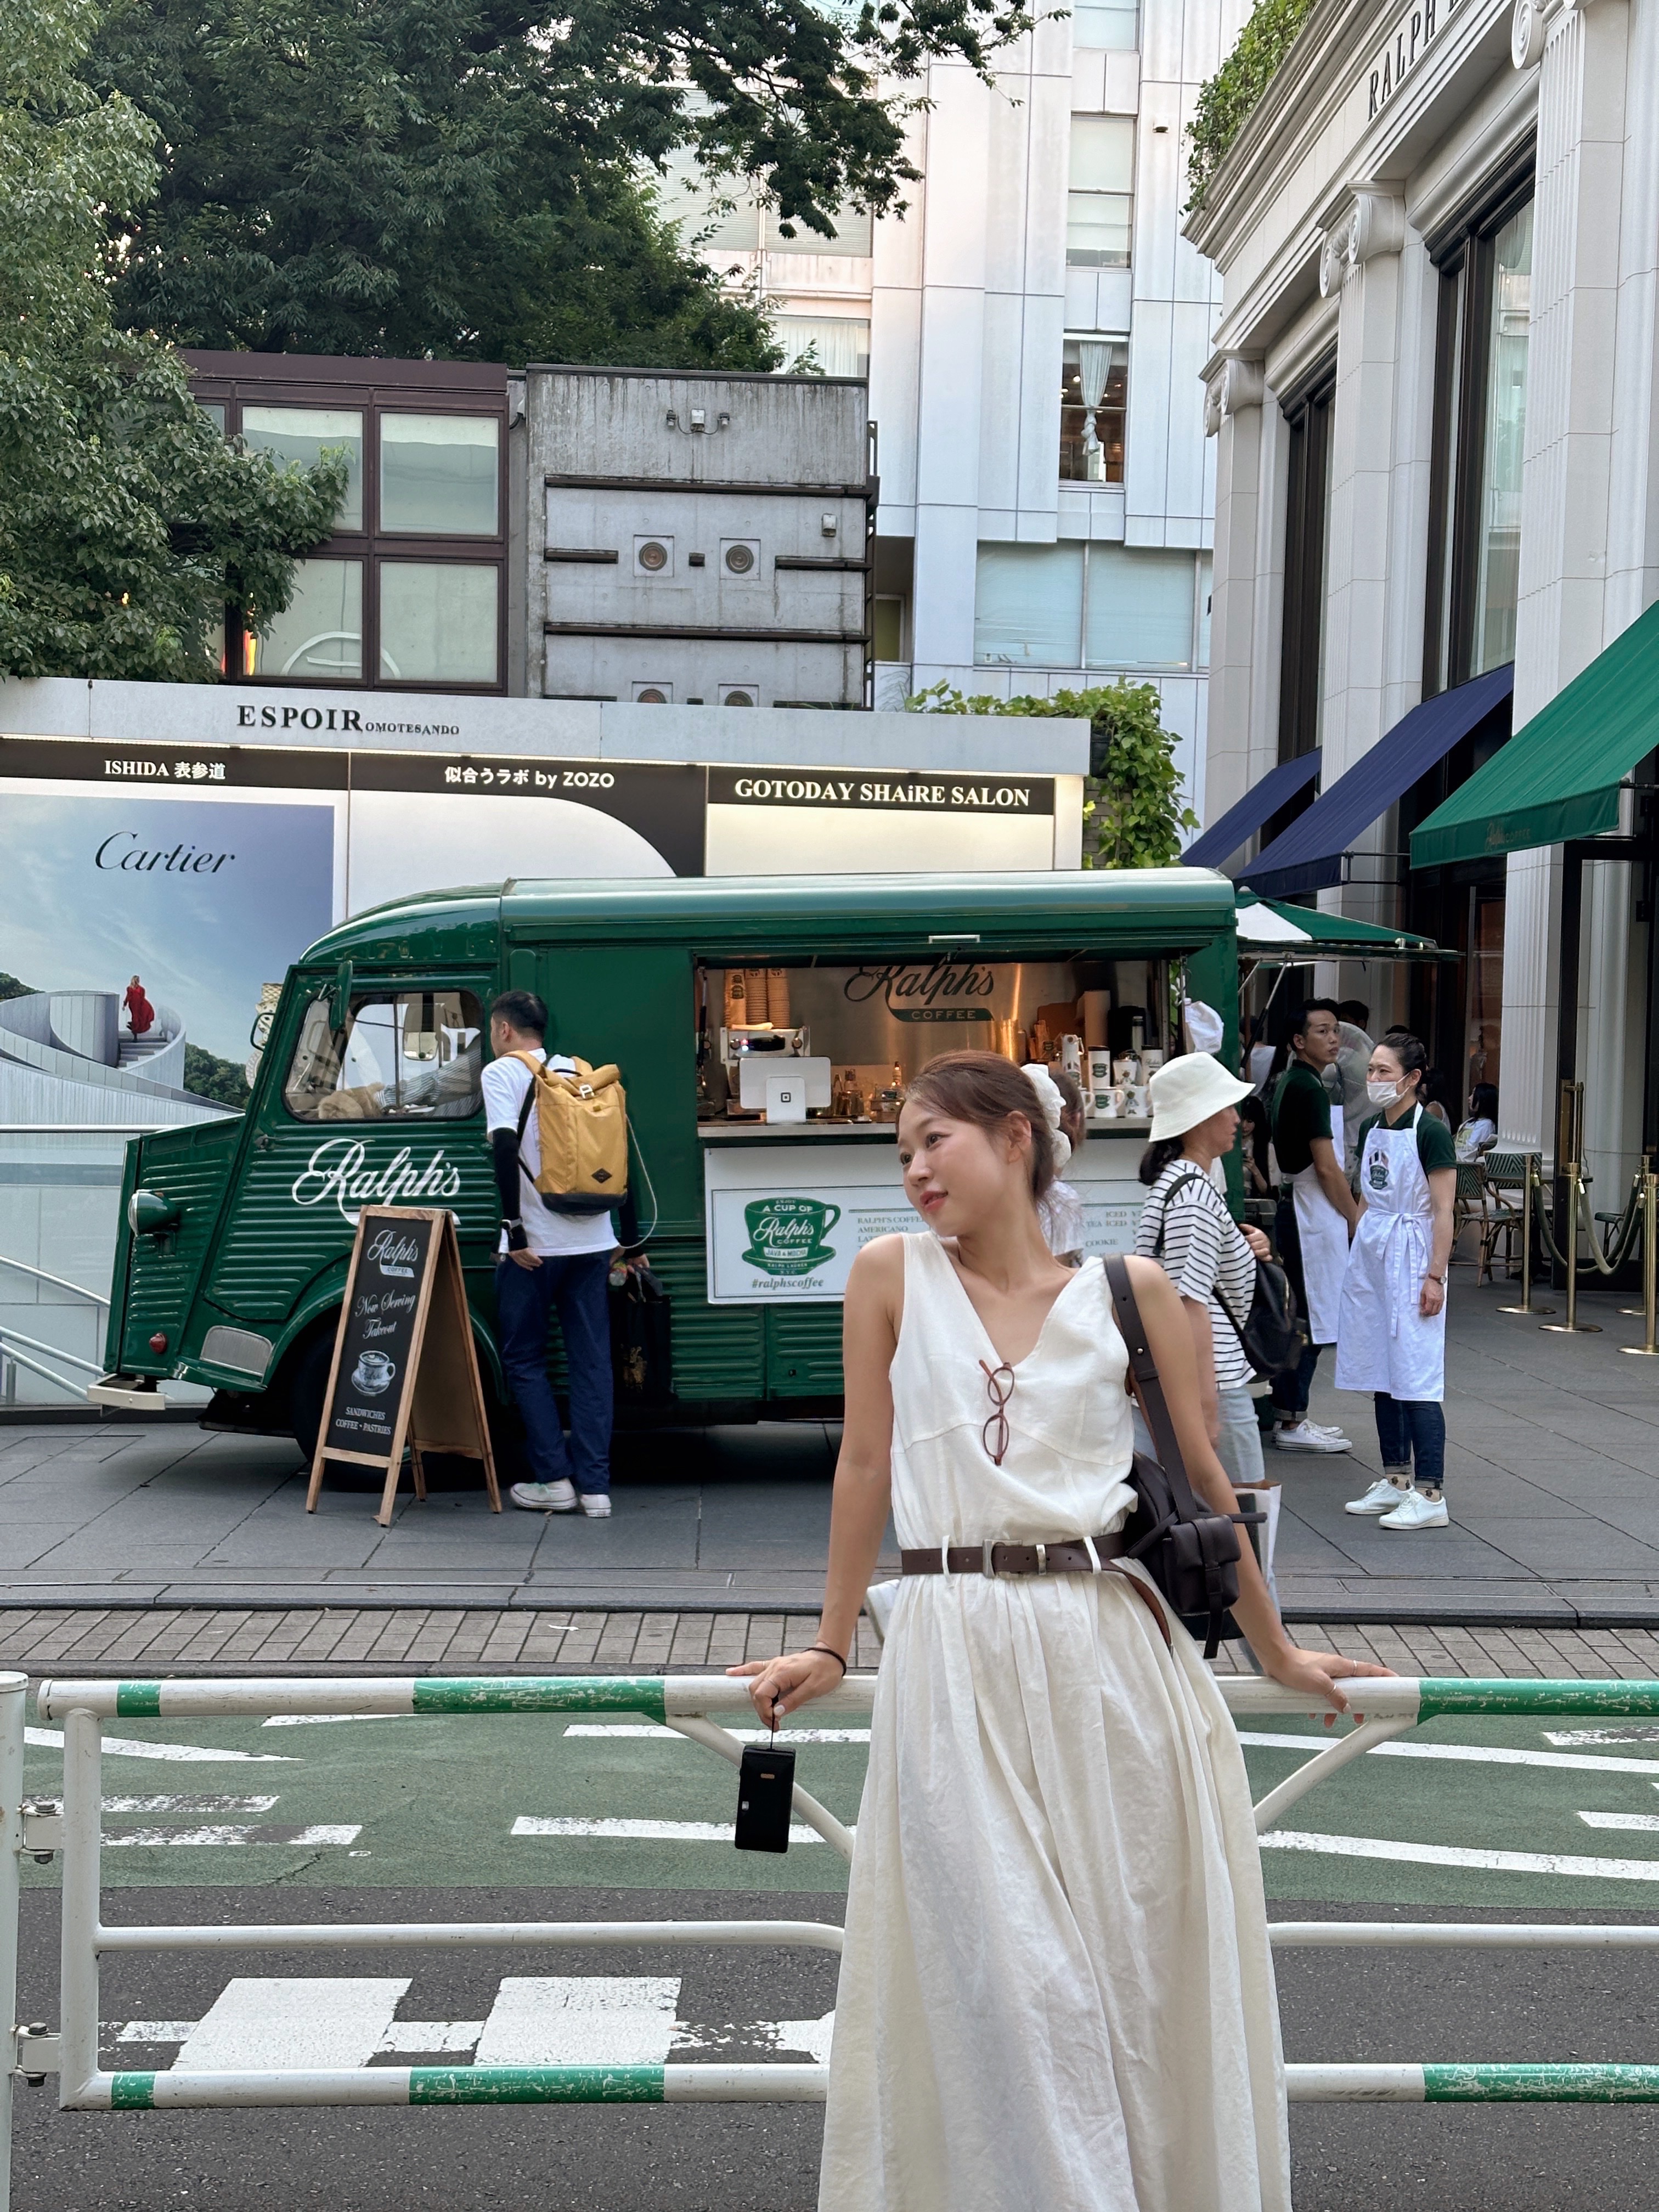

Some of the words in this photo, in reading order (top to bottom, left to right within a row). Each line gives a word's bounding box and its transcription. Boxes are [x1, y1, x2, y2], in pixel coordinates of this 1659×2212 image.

[1368, 0, 1435, 121] RALPH
[237, 704, 363, 732] ESPOIR
[365, 721, 460, 736] OMOTESANDO
[104, 759, 170, 776] ISHIDA
[174, 761, 225, 780] 表参道
[444, 766, 529, 786] 似合うラボ
[535, 770, 558, 789] by
[562, 772, 614, 788] ZOZO
[735, 778, 854, 801] GOTODAY
[951, 786, 1030, 806] SALON
[95, 831, 235, 873] Cartier
[911, 1011, 975, 1019] COFFEE
[292, 1138, 461, 1215] Ralph's
[753, 1217, 814, 1244] Ralph's
[752, 1277, 824, 1290] #ralphscoffee
